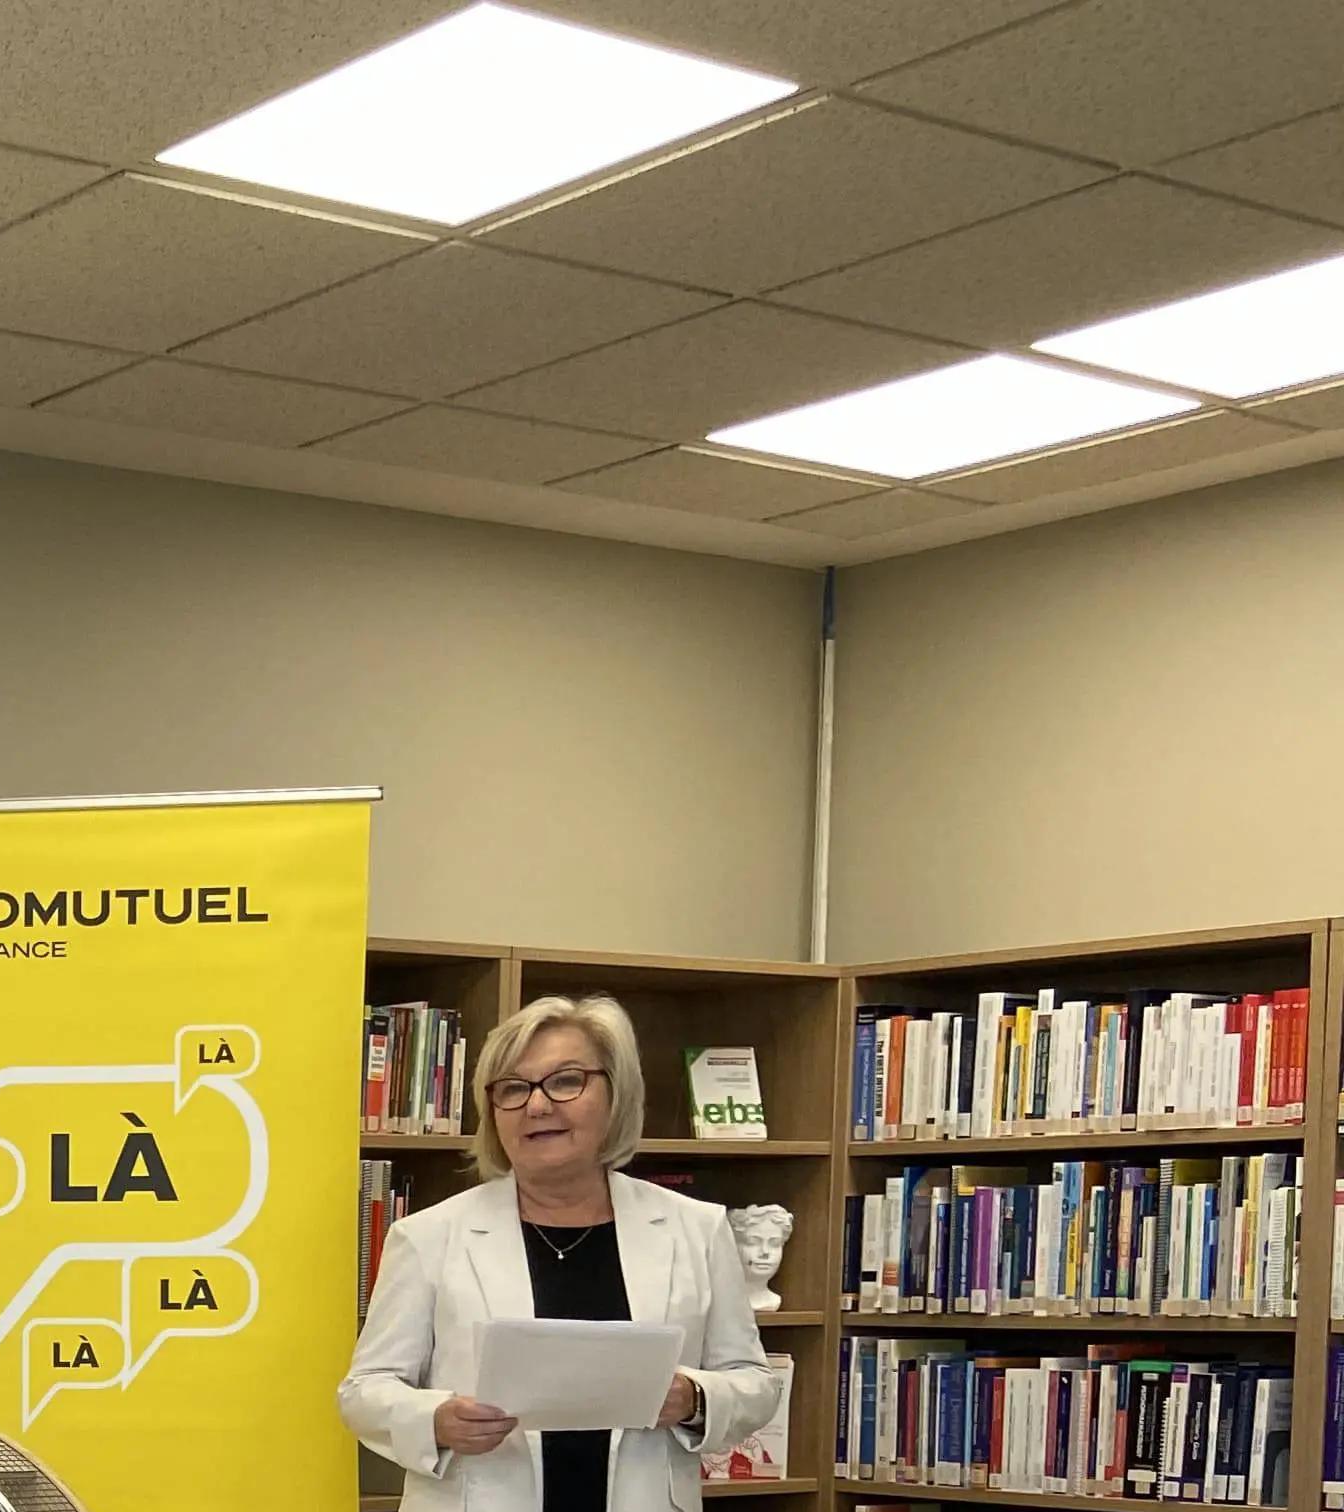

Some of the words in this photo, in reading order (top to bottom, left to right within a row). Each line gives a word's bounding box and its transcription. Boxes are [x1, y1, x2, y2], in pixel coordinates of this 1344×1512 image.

[198, 1039, 235, 1064] LÀ
[50, 1112, 178, 1203] LÀ
[159, 1270, 218, 1311] LÀ
[52, 1334, 100, 1369] LÀ
